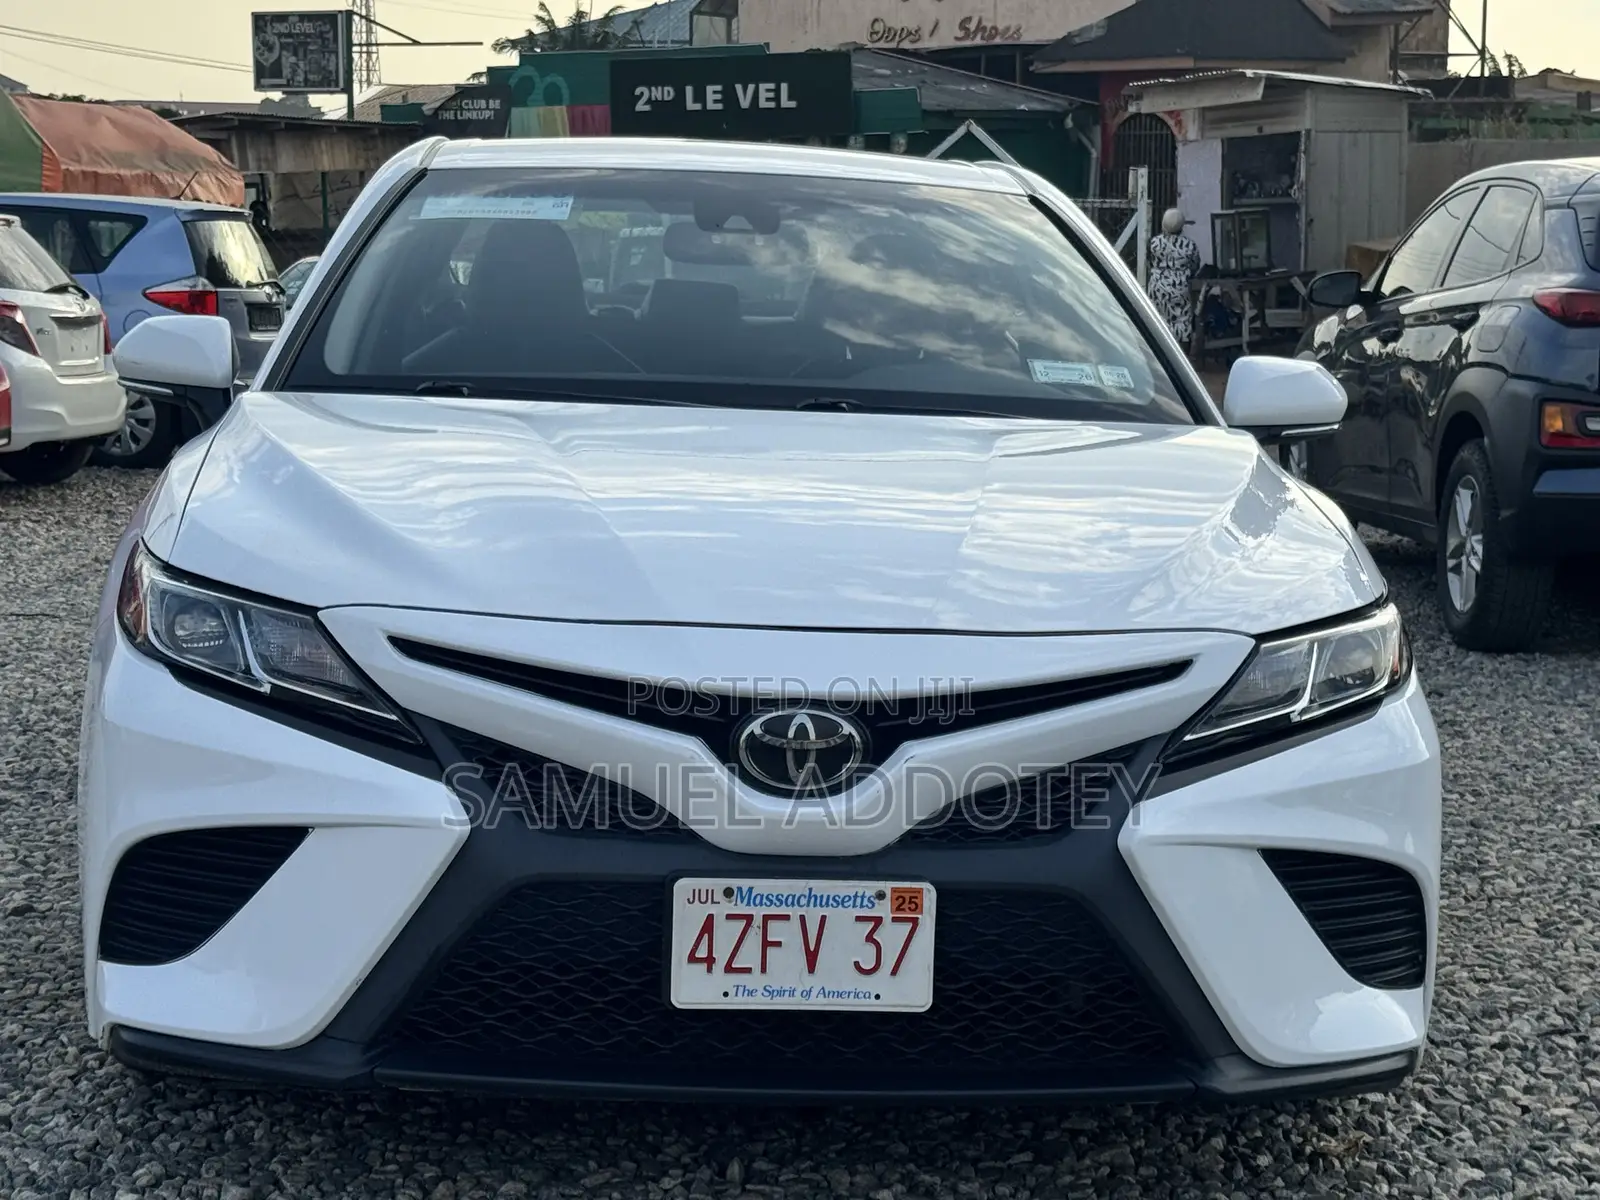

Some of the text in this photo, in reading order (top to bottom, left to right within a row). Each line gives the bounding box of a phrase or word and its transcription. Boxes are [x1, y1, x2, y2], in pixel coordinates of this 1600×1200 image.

[461, 99, 487, 109] CLUB
[488, 99, 501, 109] BE
[634, 86, 675, 112] 2ND
[438, 110, 455, 120] THE
[686, 886, 877, 910] JUL Massachusetts
[895, 895, 919, 912] 25
[853, 915, 921, 977] 37
[732, 984, 872, 1001] The Spirit of America
